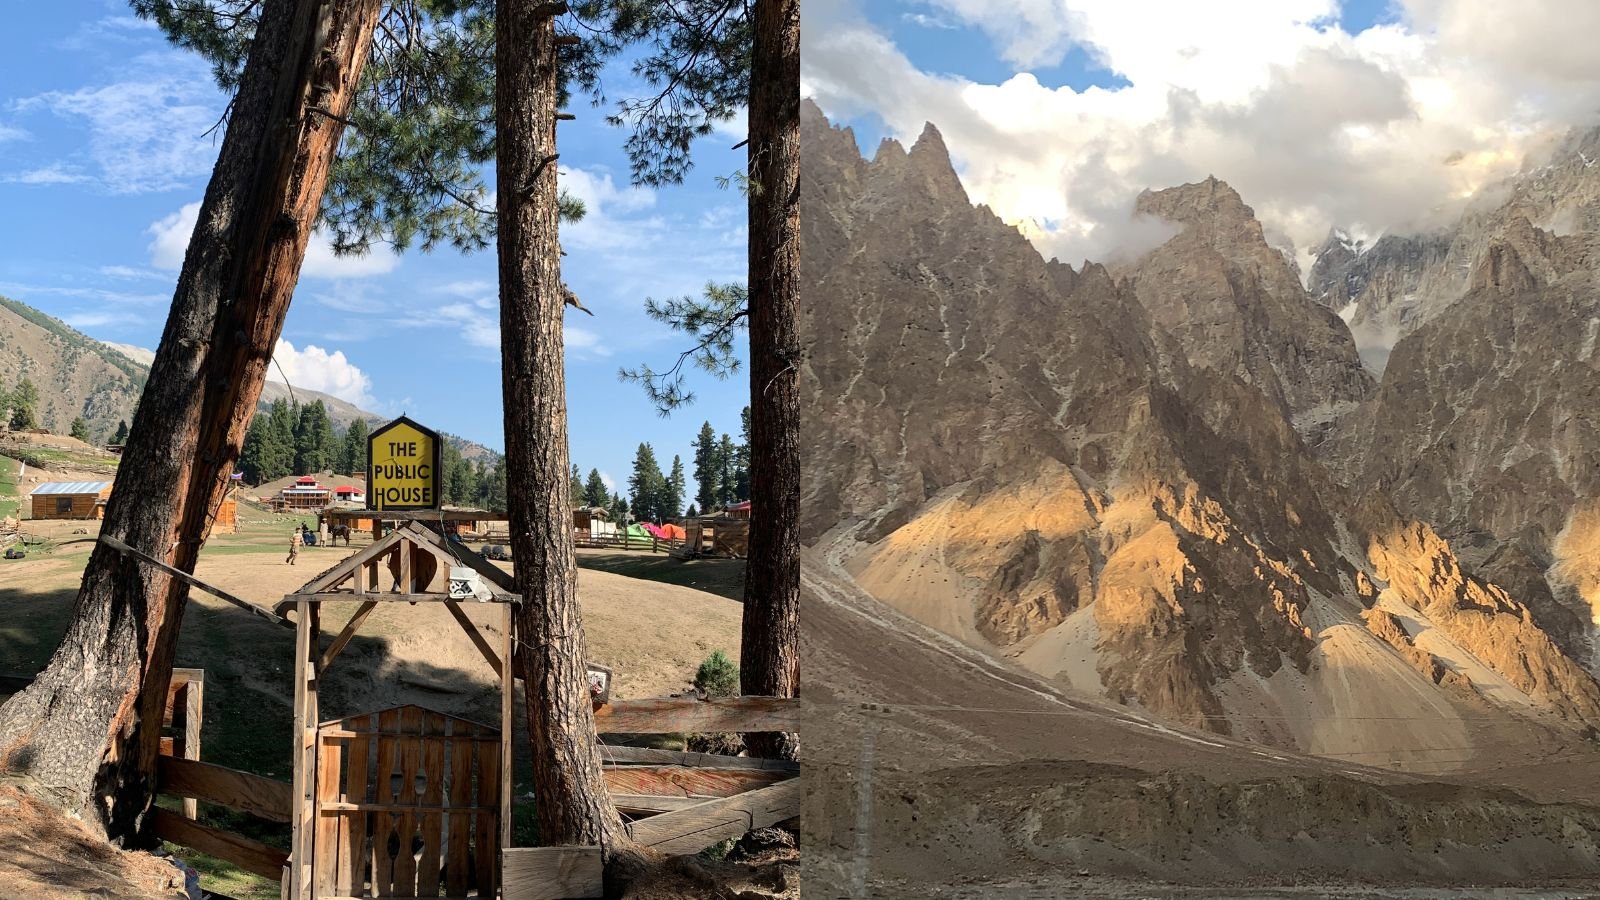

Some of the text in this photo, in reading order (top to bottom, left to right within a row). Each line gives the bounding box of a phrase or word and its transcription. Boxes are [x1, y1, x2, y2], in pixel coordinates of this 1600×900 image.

[389, 442, 416, 456] THE
[375, 465, 430, 479] PUBLIC
[375, 488, 431, 503] HOUSE
